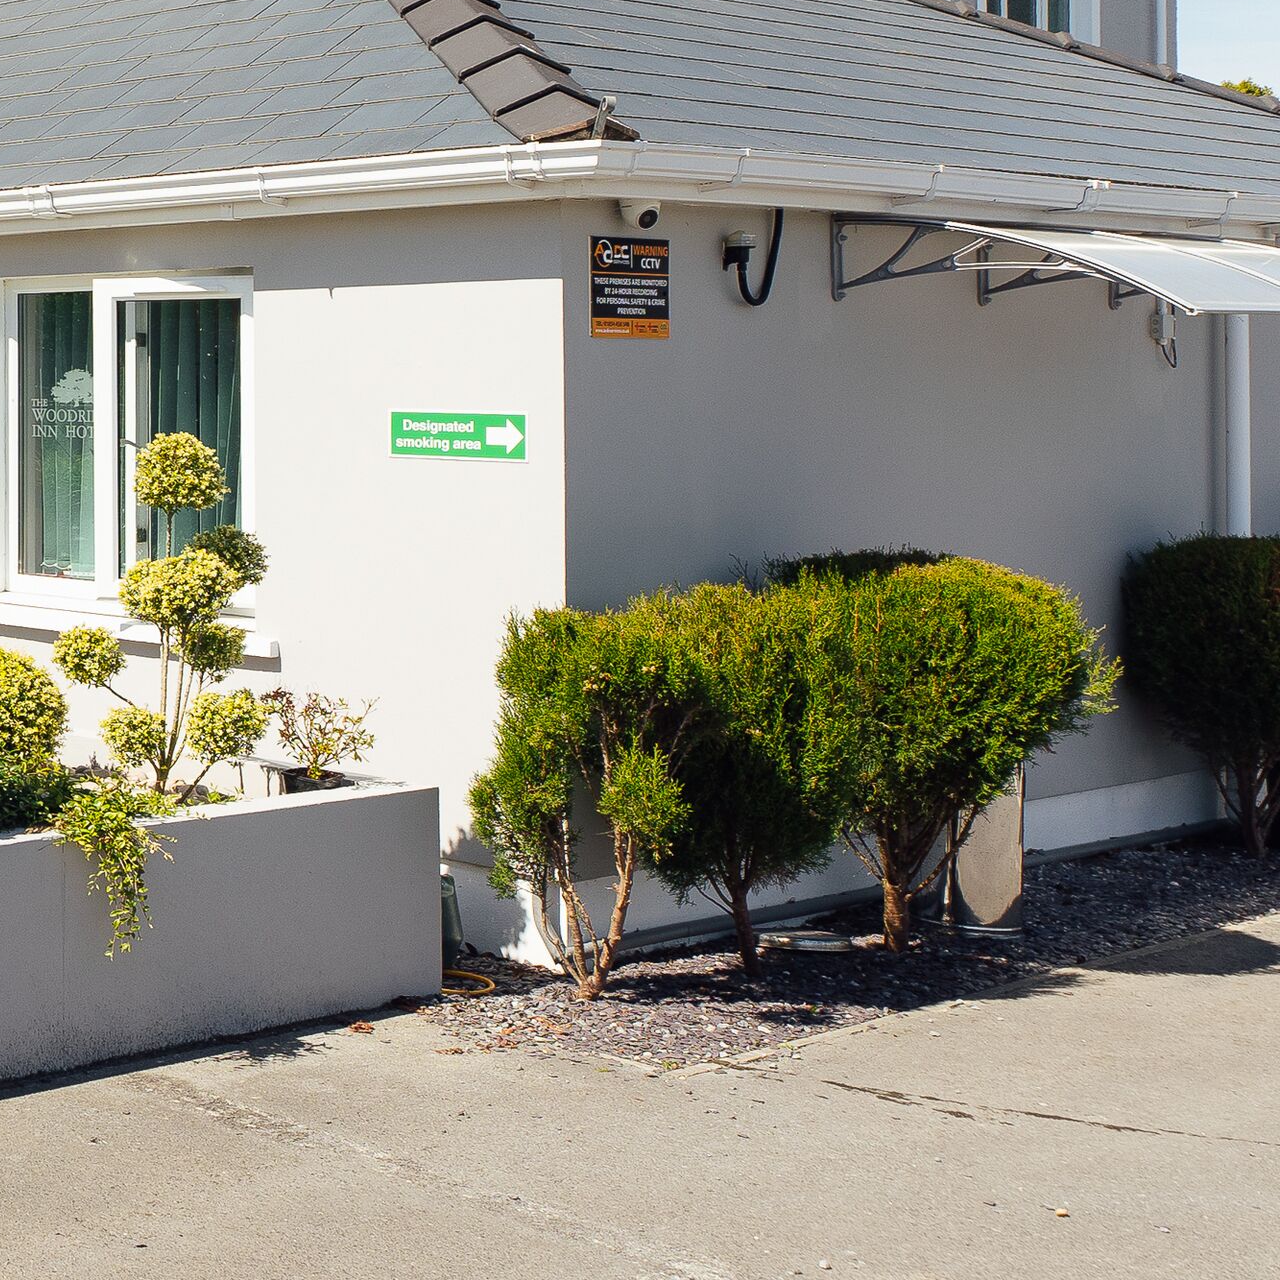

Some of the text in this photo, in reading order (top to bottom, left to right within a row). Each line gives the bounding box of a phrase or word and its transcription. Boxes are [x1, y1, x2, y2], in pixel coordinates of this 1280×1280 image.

[633, 245, 669, 256] WARNING
[641, 258, 661, 269] CCTV
[31, 398, 48, 407] THE
[32, 408, 93, 423] WOODRI
[32, 424, 58, 440] INN
[402, 419, 475, 434] Designated
[395, 436, 482, 452] smoking area
